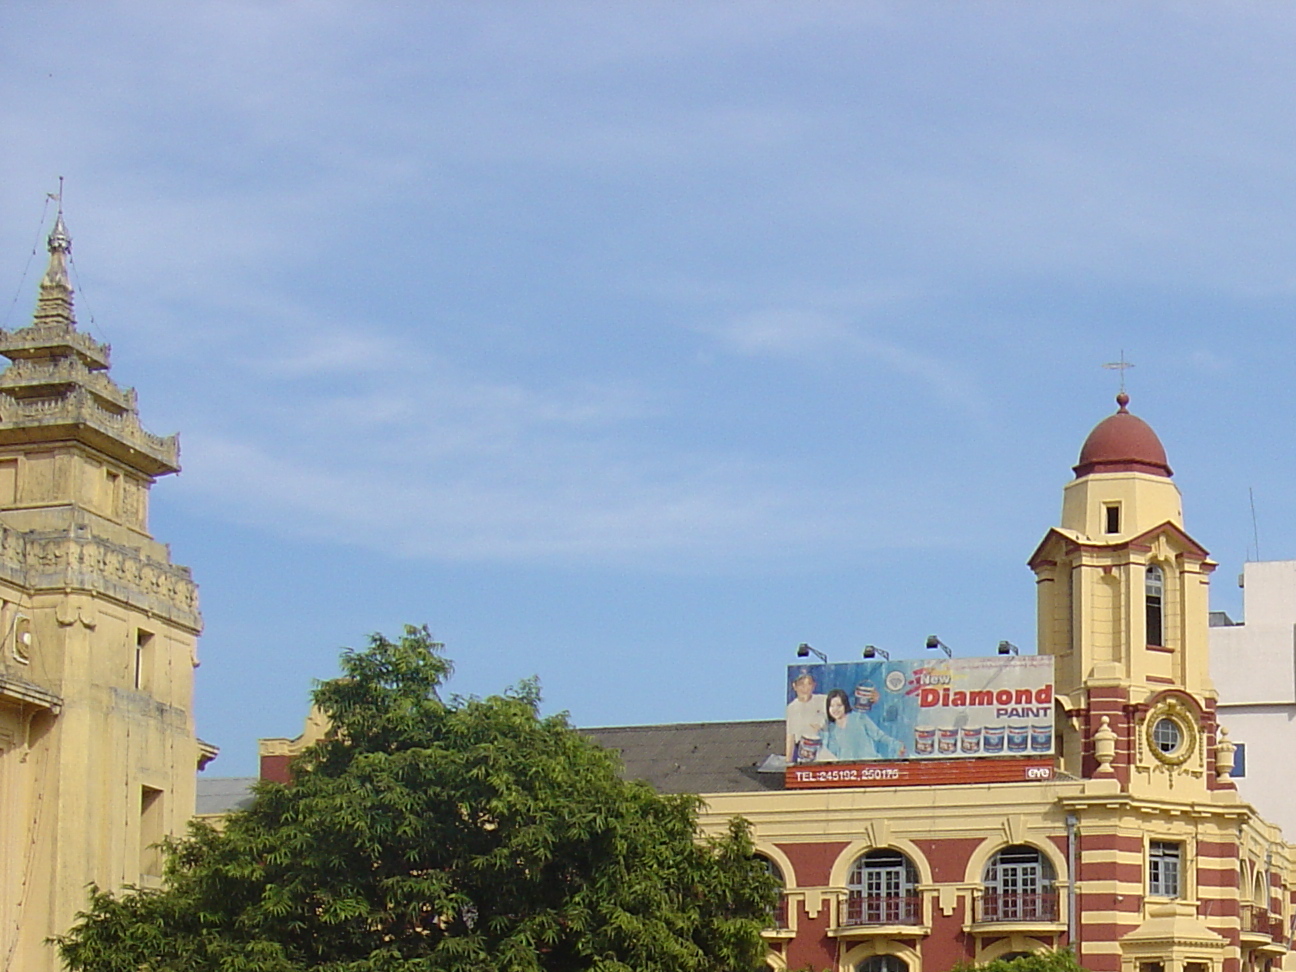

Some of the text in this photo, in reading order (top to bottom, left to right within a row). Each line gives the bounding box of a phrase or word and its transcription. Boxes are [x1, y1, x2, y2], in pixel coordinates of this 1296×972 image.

[920, 674, 951, 686] New
[920, 684, 1053, 709] Diamond
[996, 706, 1051, 719] PAINT
